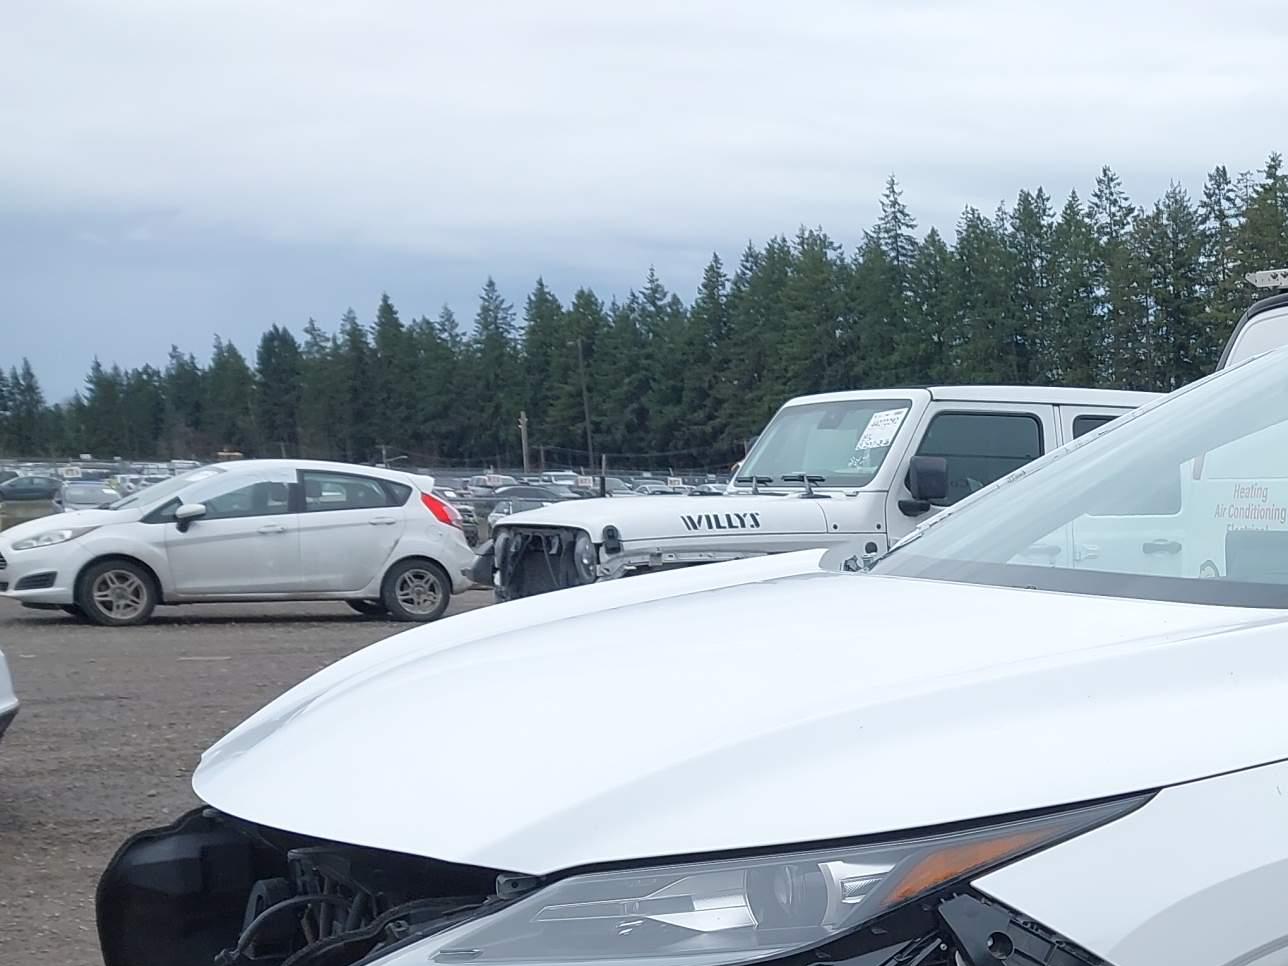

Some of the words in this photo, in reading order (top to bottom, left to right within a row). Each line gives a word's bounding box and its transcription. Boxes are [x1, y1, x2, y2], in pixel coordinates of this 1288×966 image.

[1233, 483, 1268, 502] Heating
[680, 512, 760, 531] WILLYS
[1214, 504, 1226, 519] Air
[1227, 504, 1287, 524] Conditioning
